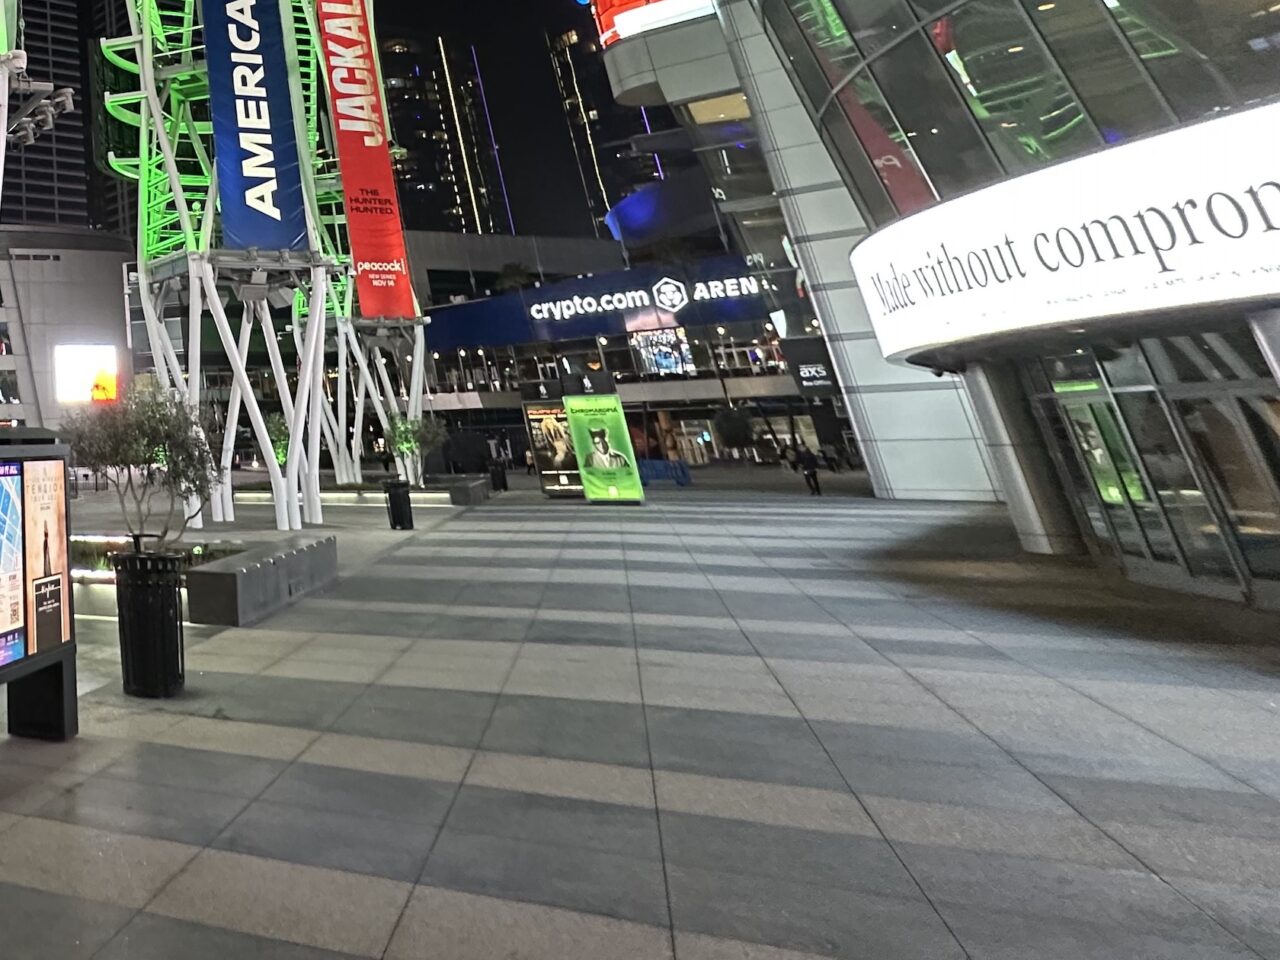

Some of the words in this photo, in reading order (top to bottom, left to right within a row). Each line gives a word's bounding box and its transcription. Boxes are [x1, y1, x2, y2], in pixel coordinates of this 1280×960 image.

[360, 189, 379, 197] THE
[357, 259, 402, 274] peacock
[913, 234, 1027, 298] without
[530, 289, 650, 321] crypto.com
[799, 367, 827, 378] axs
